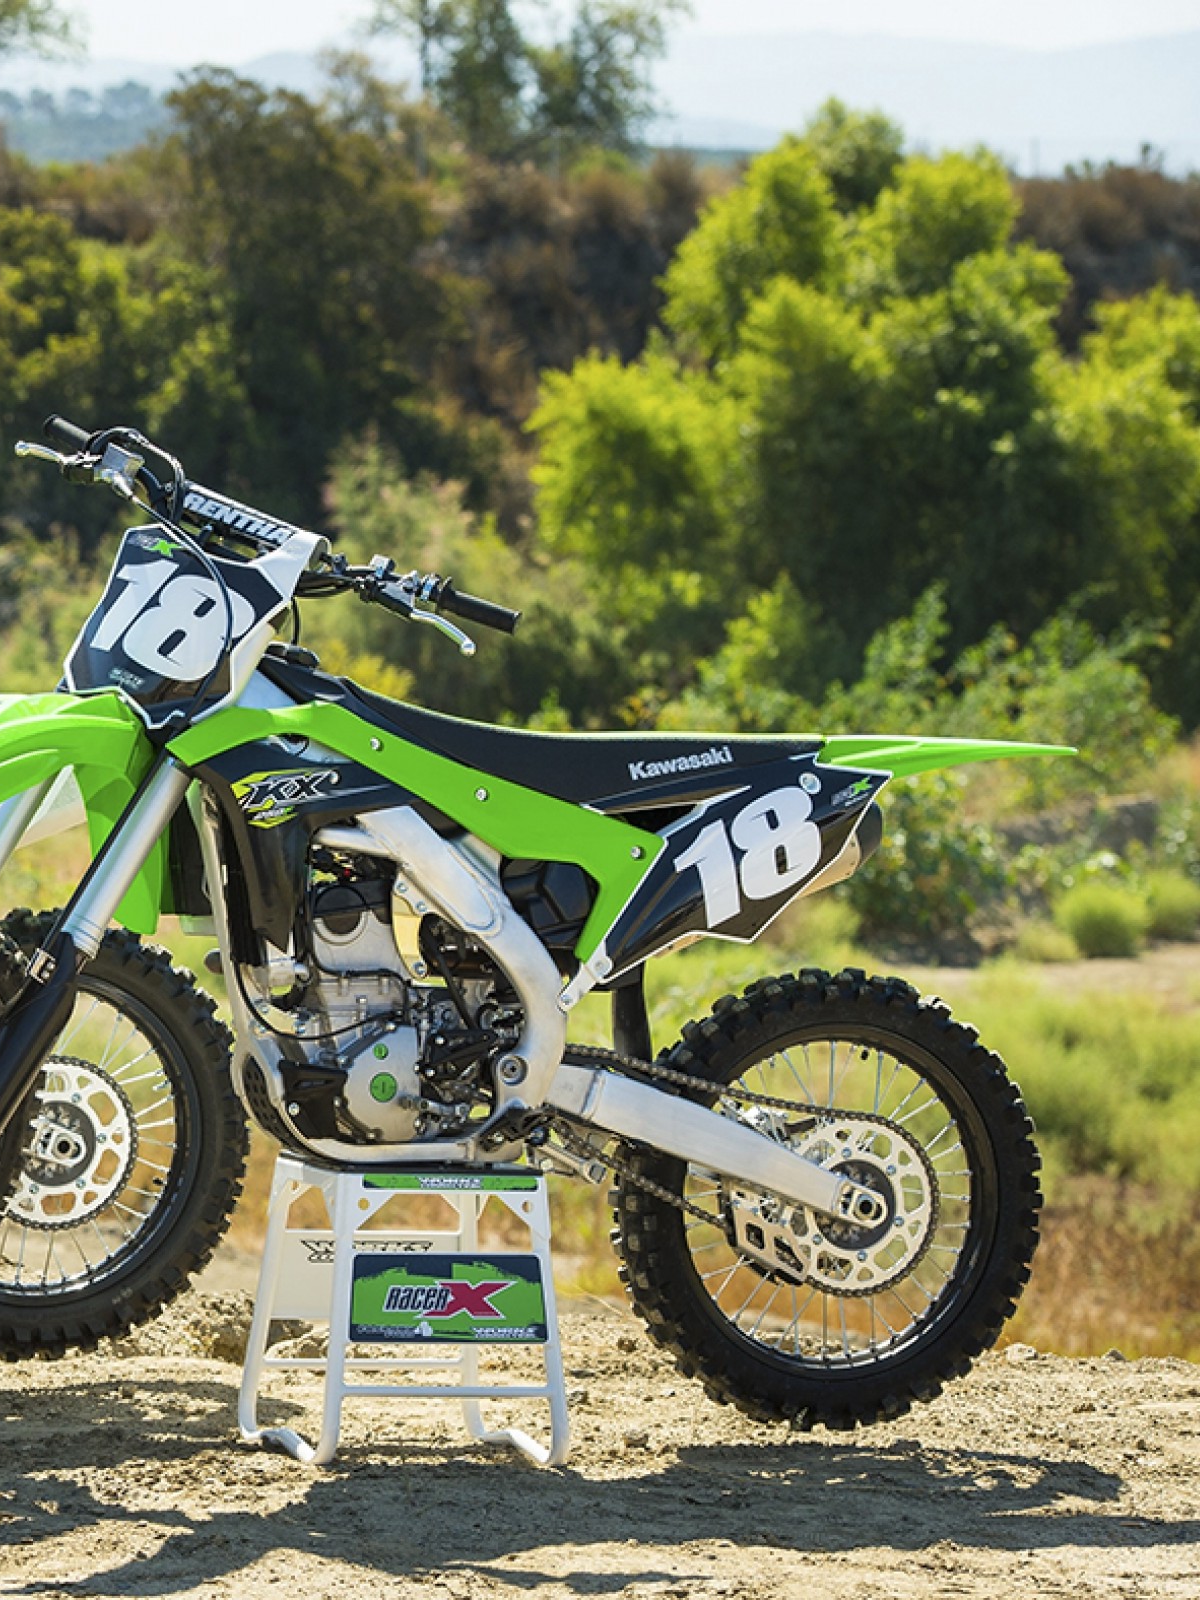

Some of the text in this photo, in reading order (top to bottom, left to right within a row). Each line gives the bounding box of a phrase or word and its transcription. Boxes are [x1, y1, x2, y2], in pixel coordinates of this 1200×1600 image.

[184, 492, 293, 544] RENTHA
[89, 559, 257, 682] 18
[628, 746, 733, 780] Kawasaki
[242, 771, 332, 809] KX
[674, 786, 822, 928] 18
[415, 1280, 517, 1318] X
